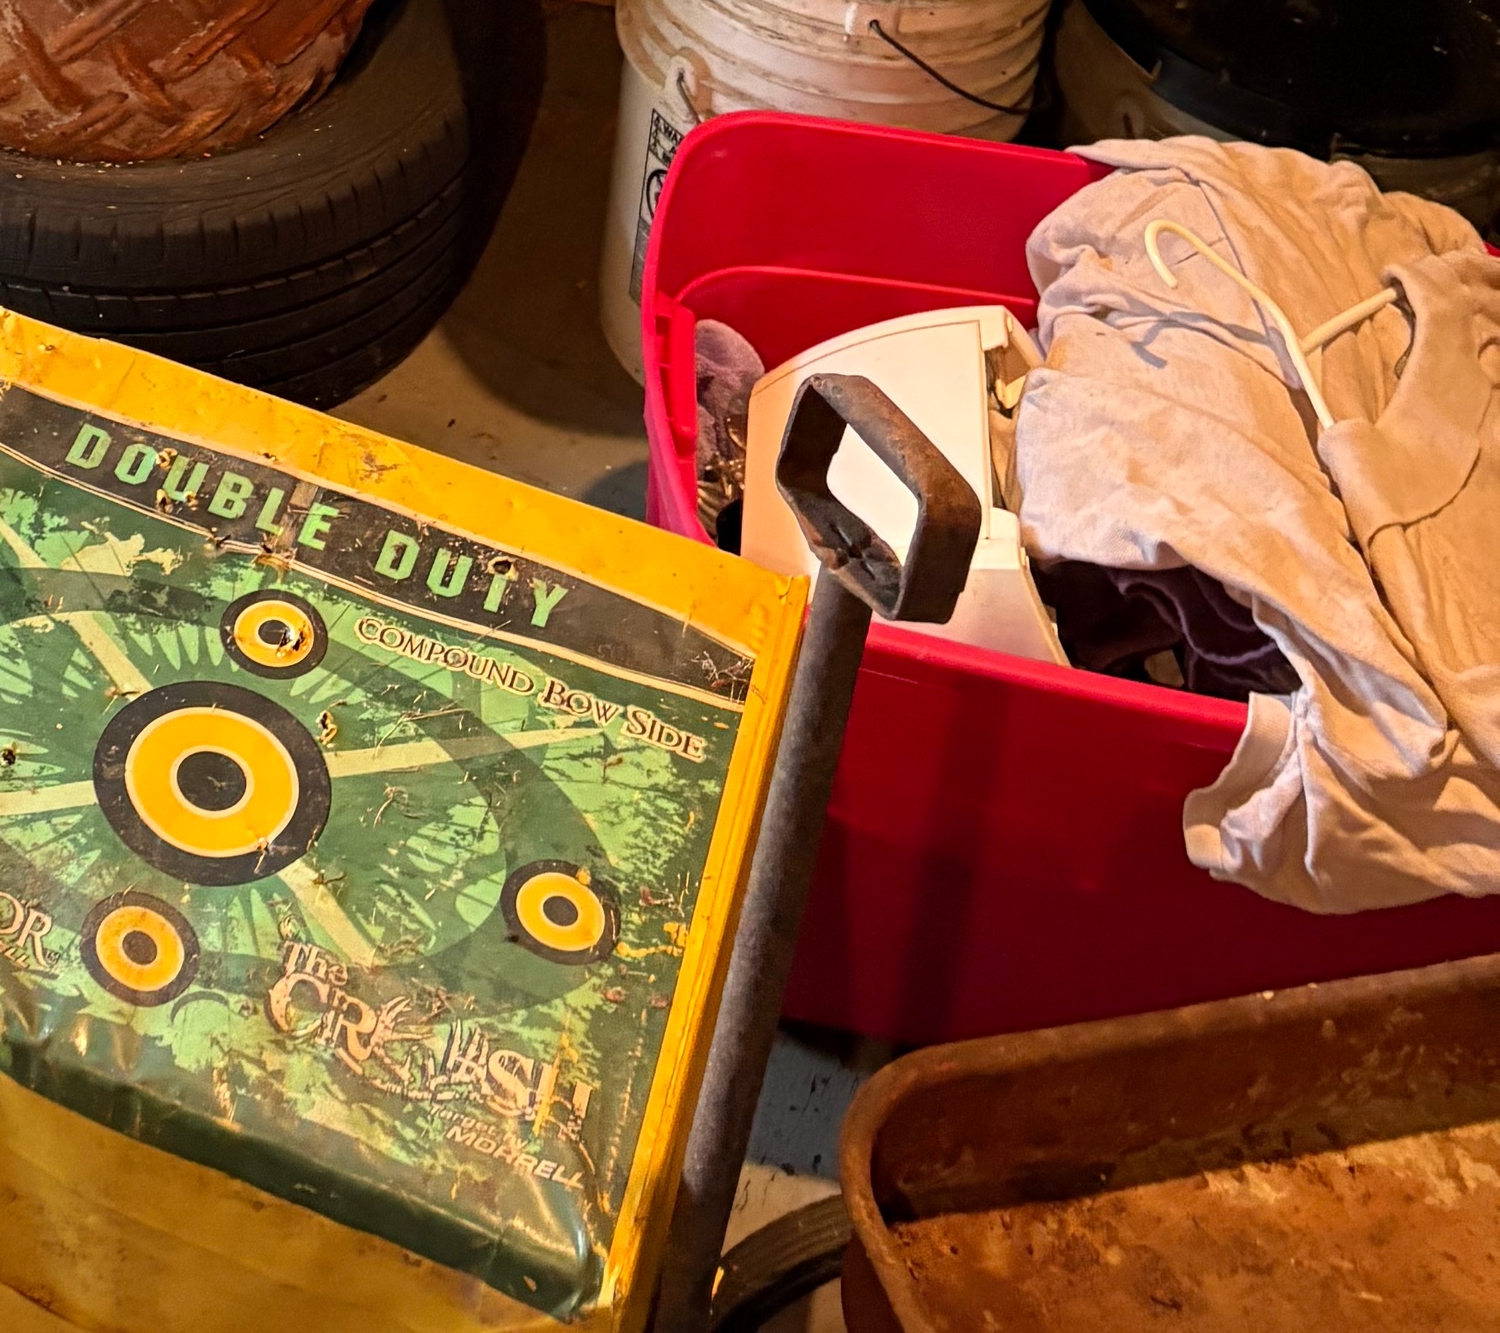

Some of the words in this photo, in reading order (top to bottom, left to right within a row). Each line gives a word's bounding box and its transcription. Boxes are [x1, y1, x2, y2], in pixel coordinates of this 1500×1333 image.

[64, 422, 340, 551] DOUBLE
[373, 528, 568, 629] DUTY
[354, 617, 534, 695] COMPOUND
[538, 676, 622, 726] BOW
[621, 705, 705, 762] SIDE
[283, 939, 348, 985] The
[446, 1125, 585, 1191] MORRELL
